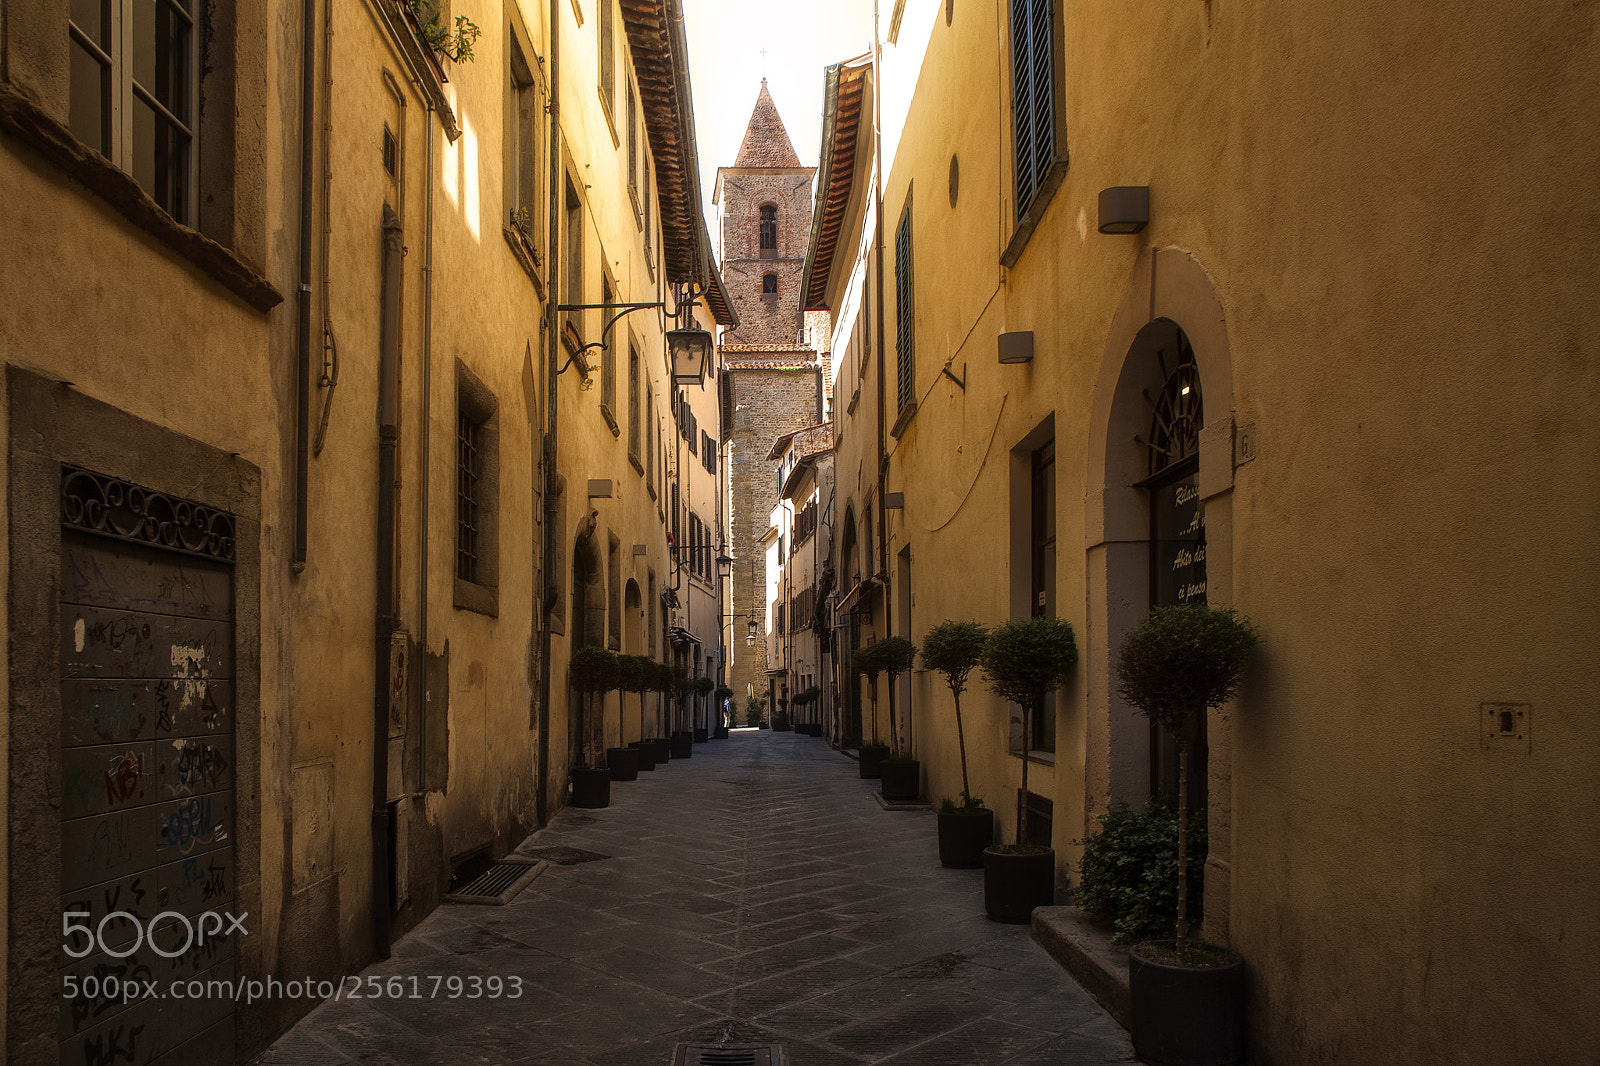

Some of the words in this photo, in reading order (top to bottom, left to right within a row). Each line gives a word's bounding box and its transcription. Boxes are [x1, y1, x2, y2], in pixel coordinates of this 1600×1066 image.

[1172, 547, 1193, 571] Abito
[1194, 544, 1205, 563] dei
[1178, 584, 1186, 600] ci
[1185, 580, 1206, 603] penso
